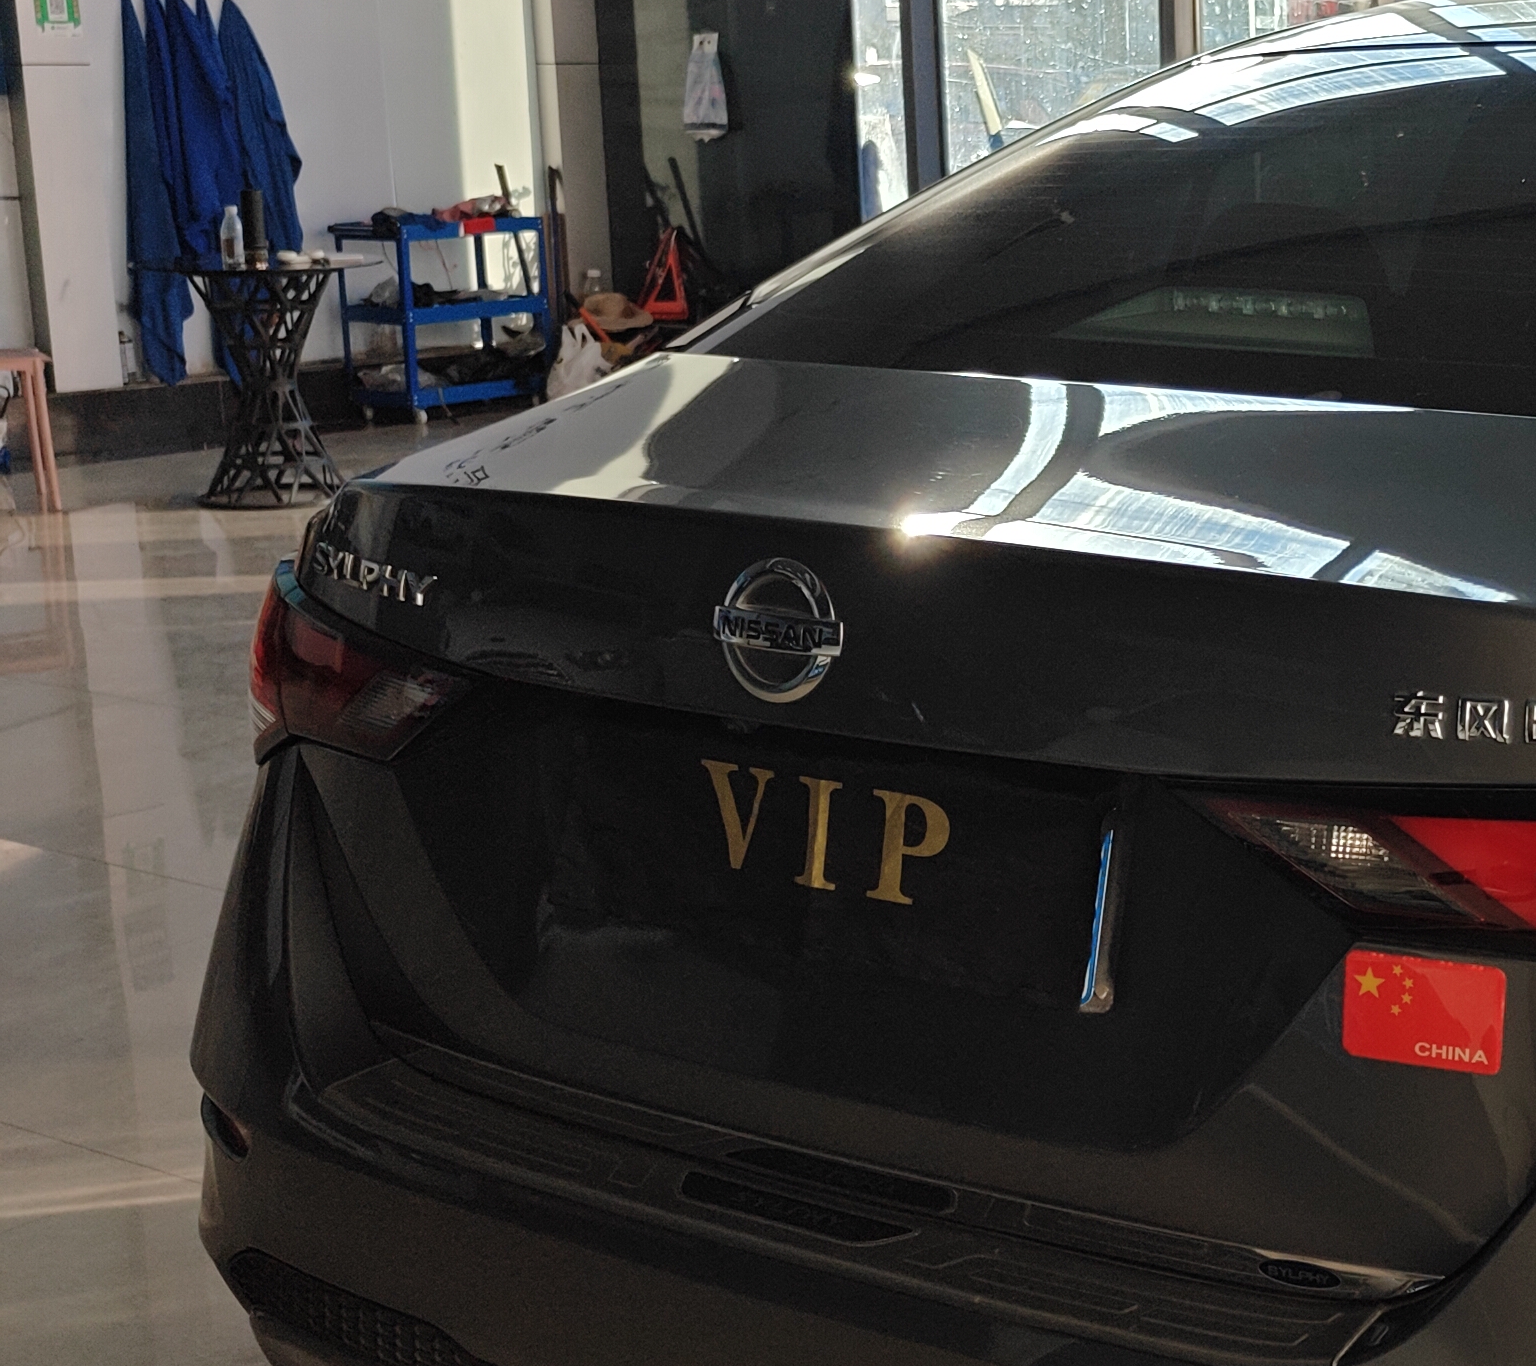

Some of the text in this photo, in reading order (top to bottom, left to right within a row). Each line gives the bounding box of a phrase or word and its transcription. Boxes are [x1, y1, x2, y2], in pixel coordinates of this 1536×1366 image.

[312, 540, 439, 607] SYLPHY
[719, 612, 825, 652] NISSAN
[700, 758, 952, 906] VIP
[1413, 1041, 1490, 1066] CHINA
